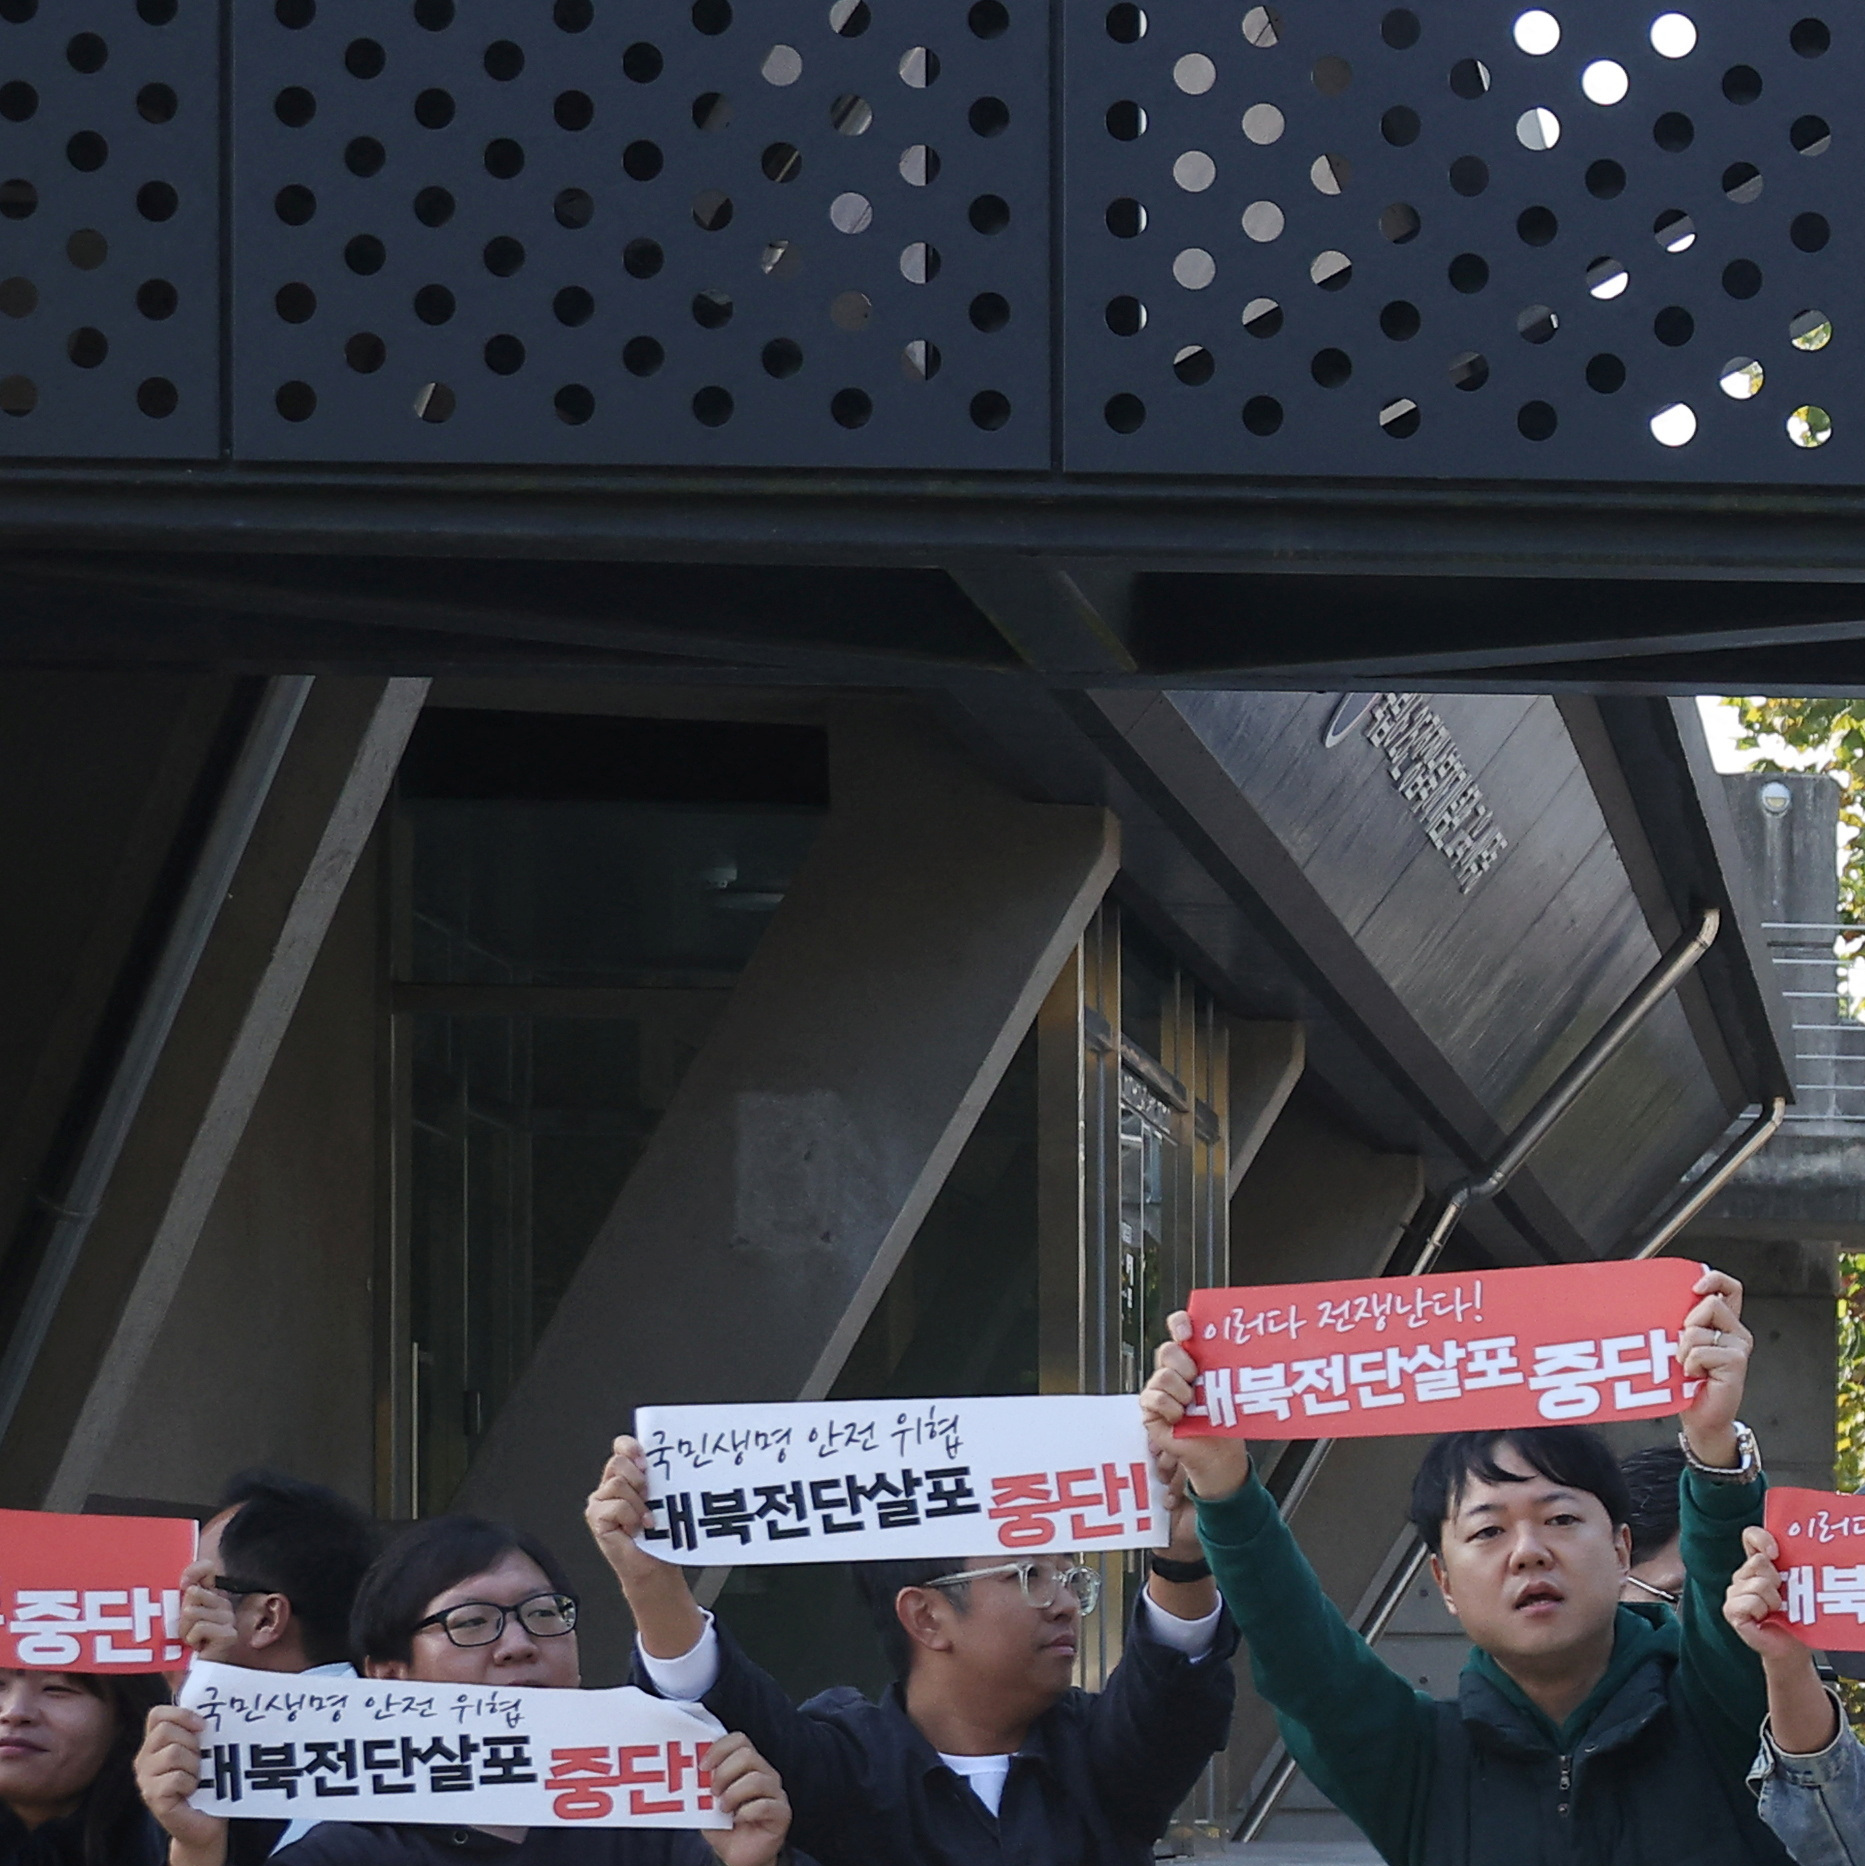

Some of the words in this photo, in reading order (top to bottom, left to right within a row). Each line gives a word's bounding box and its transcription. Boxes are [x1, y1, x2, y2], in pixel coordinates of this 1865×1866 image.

[1203, 1307, 1306, 1344] 이러다
[1317, 1280, 1485, 1334] 전쟁난다!
[1185, 1335, 1523, 1428] 대북전단살포
[1527, 1327, 1707, 1420] 중단
[646, 1426, 793, 1479] 국민생명
[809, 1419, 879, 1457] 안전
[892, 1406, 964, 1459] 위협
[643, 1466, 982, 1551] 대북전단살포
[987, 1461, 1151, 1548] 중단!
[10, 1587, 182, 1665] 중단!
[200, 1687, 342, 1725] 국민생명
[365, 1695, 437, 1720] 안전
[450, 1691, 524, 1727] 위협
[199, 1734, 537, 1801] 대북전단살포
